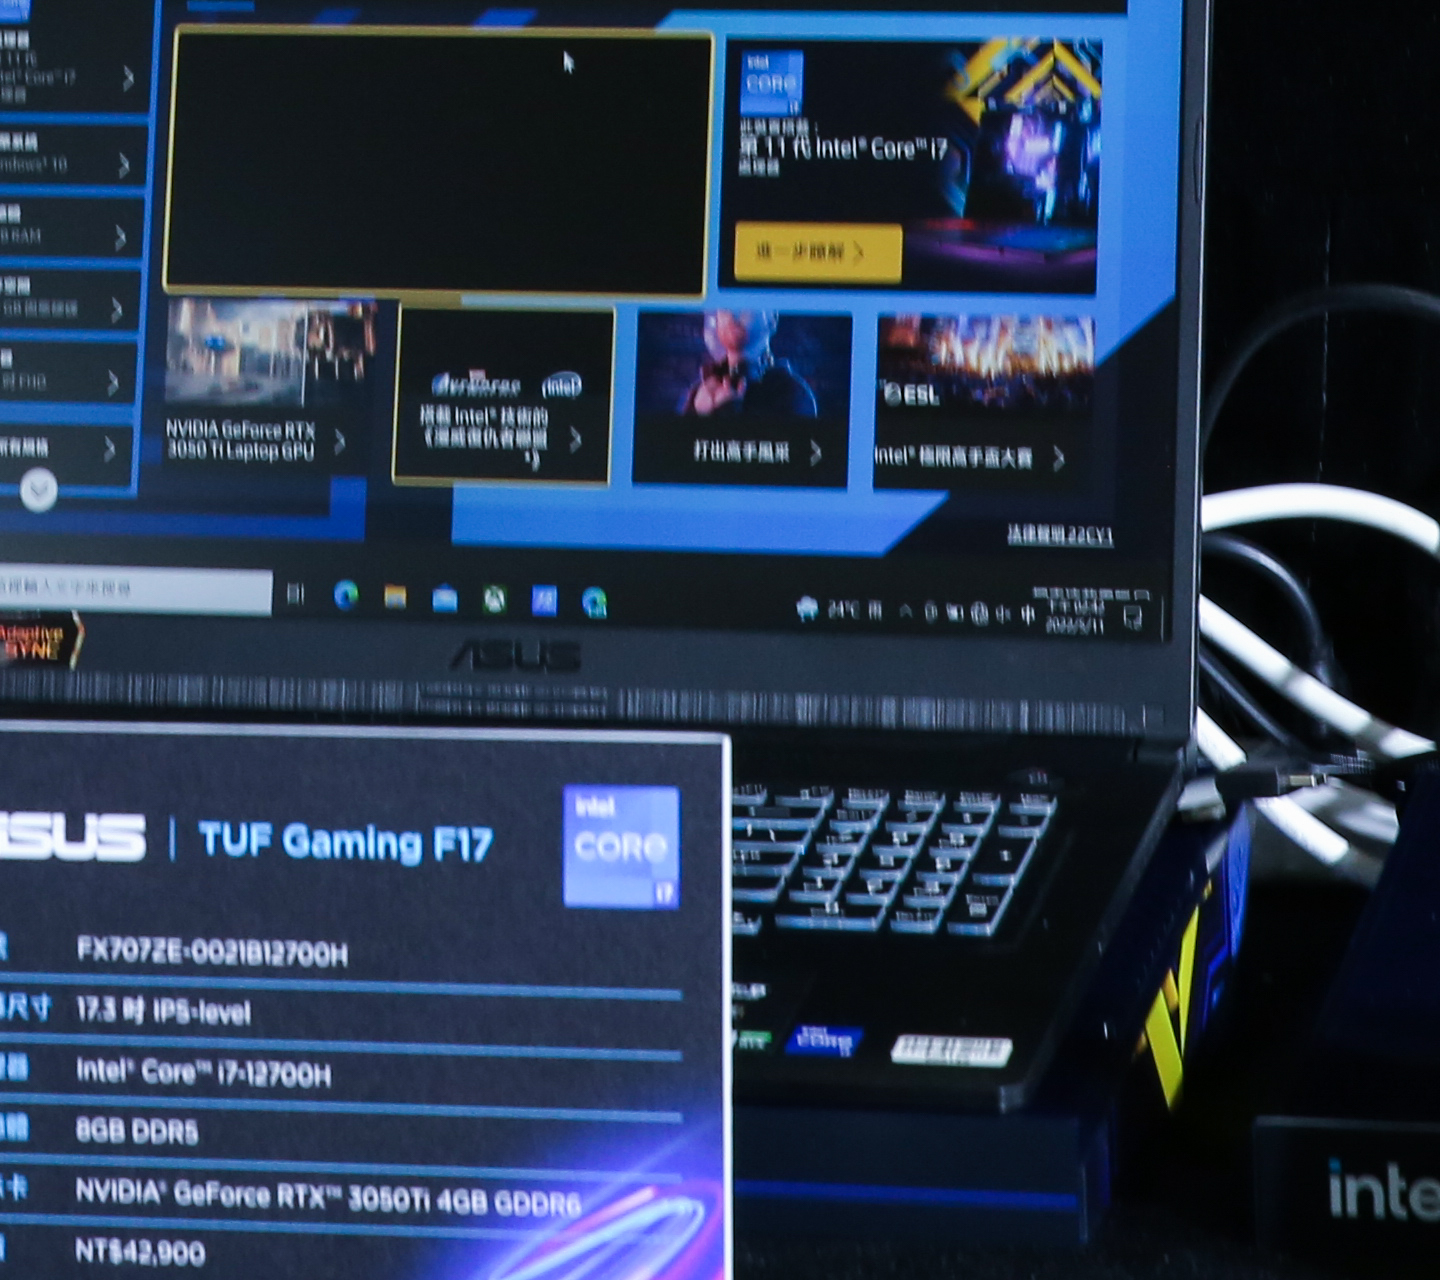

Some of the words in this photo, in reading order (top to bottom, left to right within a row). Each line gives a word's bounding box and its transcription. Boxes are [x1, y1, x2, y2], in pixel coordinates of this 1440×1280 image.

[903, 383, 940, 407] ESL
[166, 419, 218, 439] NVIDIA
[222, 419, 276, 440] GeForce
[279, 421, 316, 441] RTX
[227, 441, 277, 464] Laptop
[282, 442, 315, 462] GPU
[576, 796, 616, 818] intel
[199, 823, 271, 858] TUF
[283, 823, 423, 867] Gaming
[434, 826, 494, 863] F17
[78, 995, 117, 1022] 17.3
[76, 1116, 126, 1144] 8GB
[133, 1118, 199, 1146] DDR5
[174, 1179, 270, 1209] GeForce
[437, 1187, 487, 1215] 4GB
